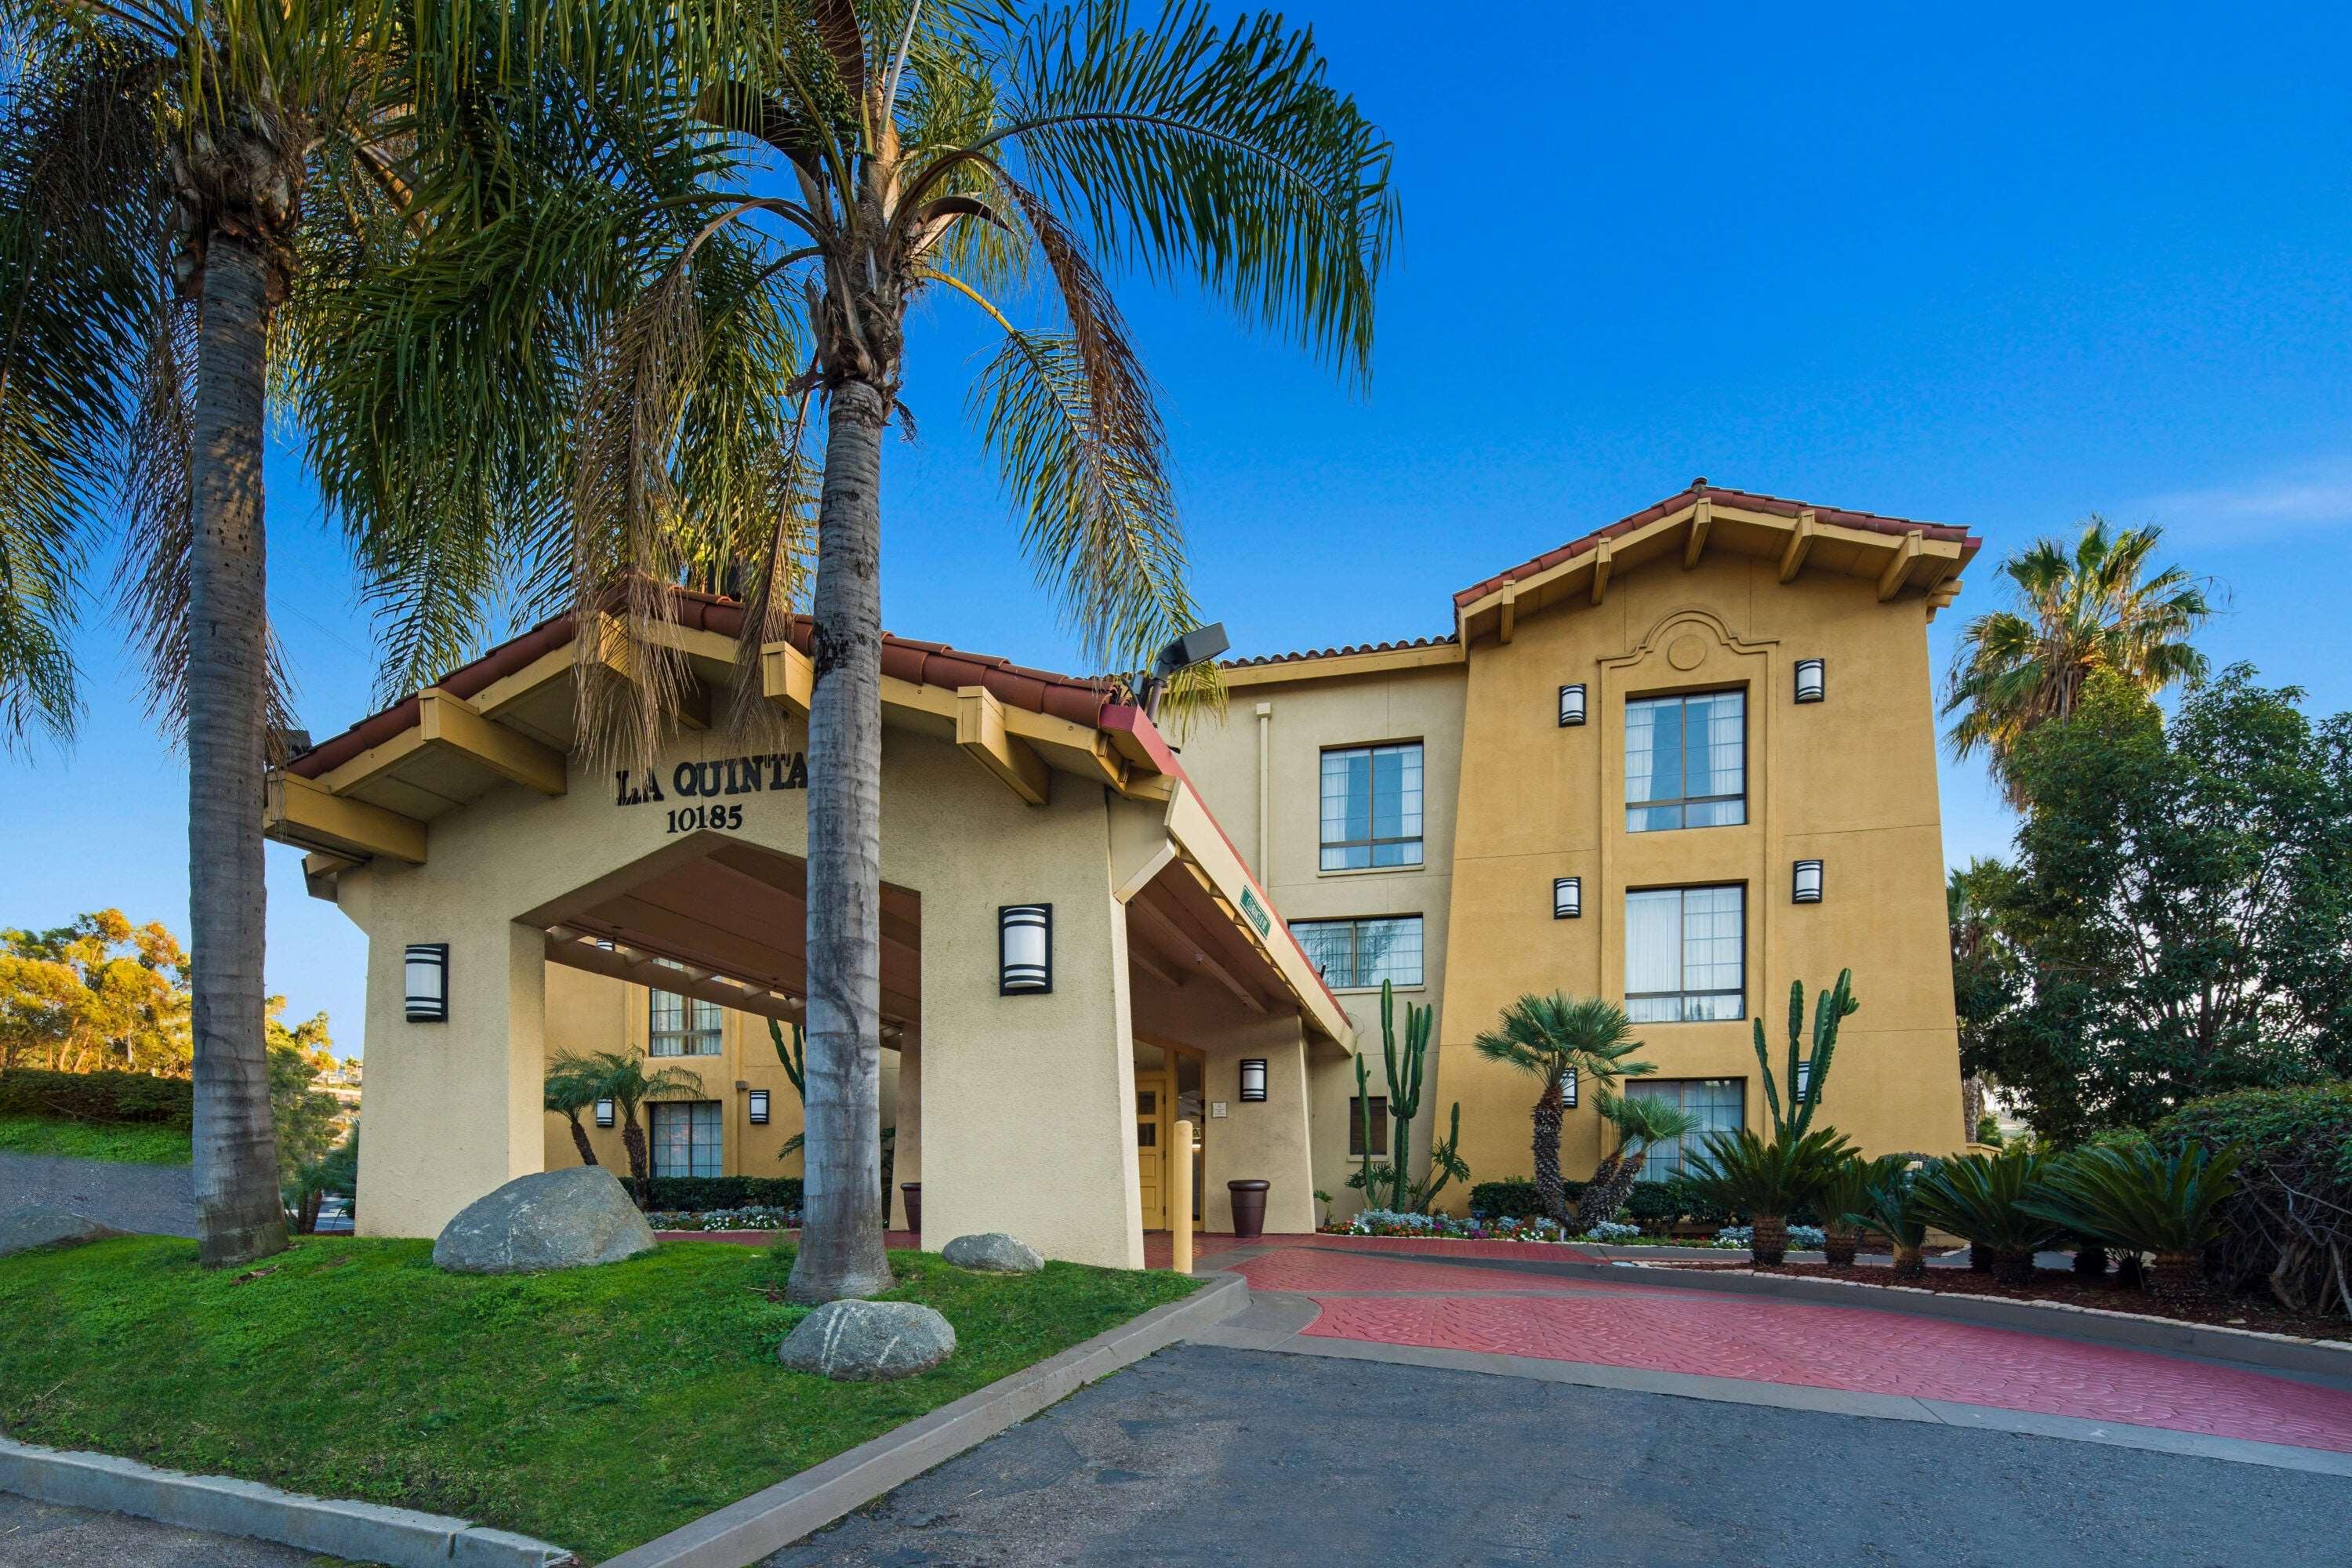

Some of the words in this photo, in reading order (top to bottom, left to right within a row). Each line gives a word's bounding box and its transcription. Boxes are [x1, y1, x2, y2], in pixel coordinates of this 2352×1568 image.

[615, 766, 664, 806] LA
[673, 752, 808, 797] QUINTA
[666, 804, 742, 833] 10185
